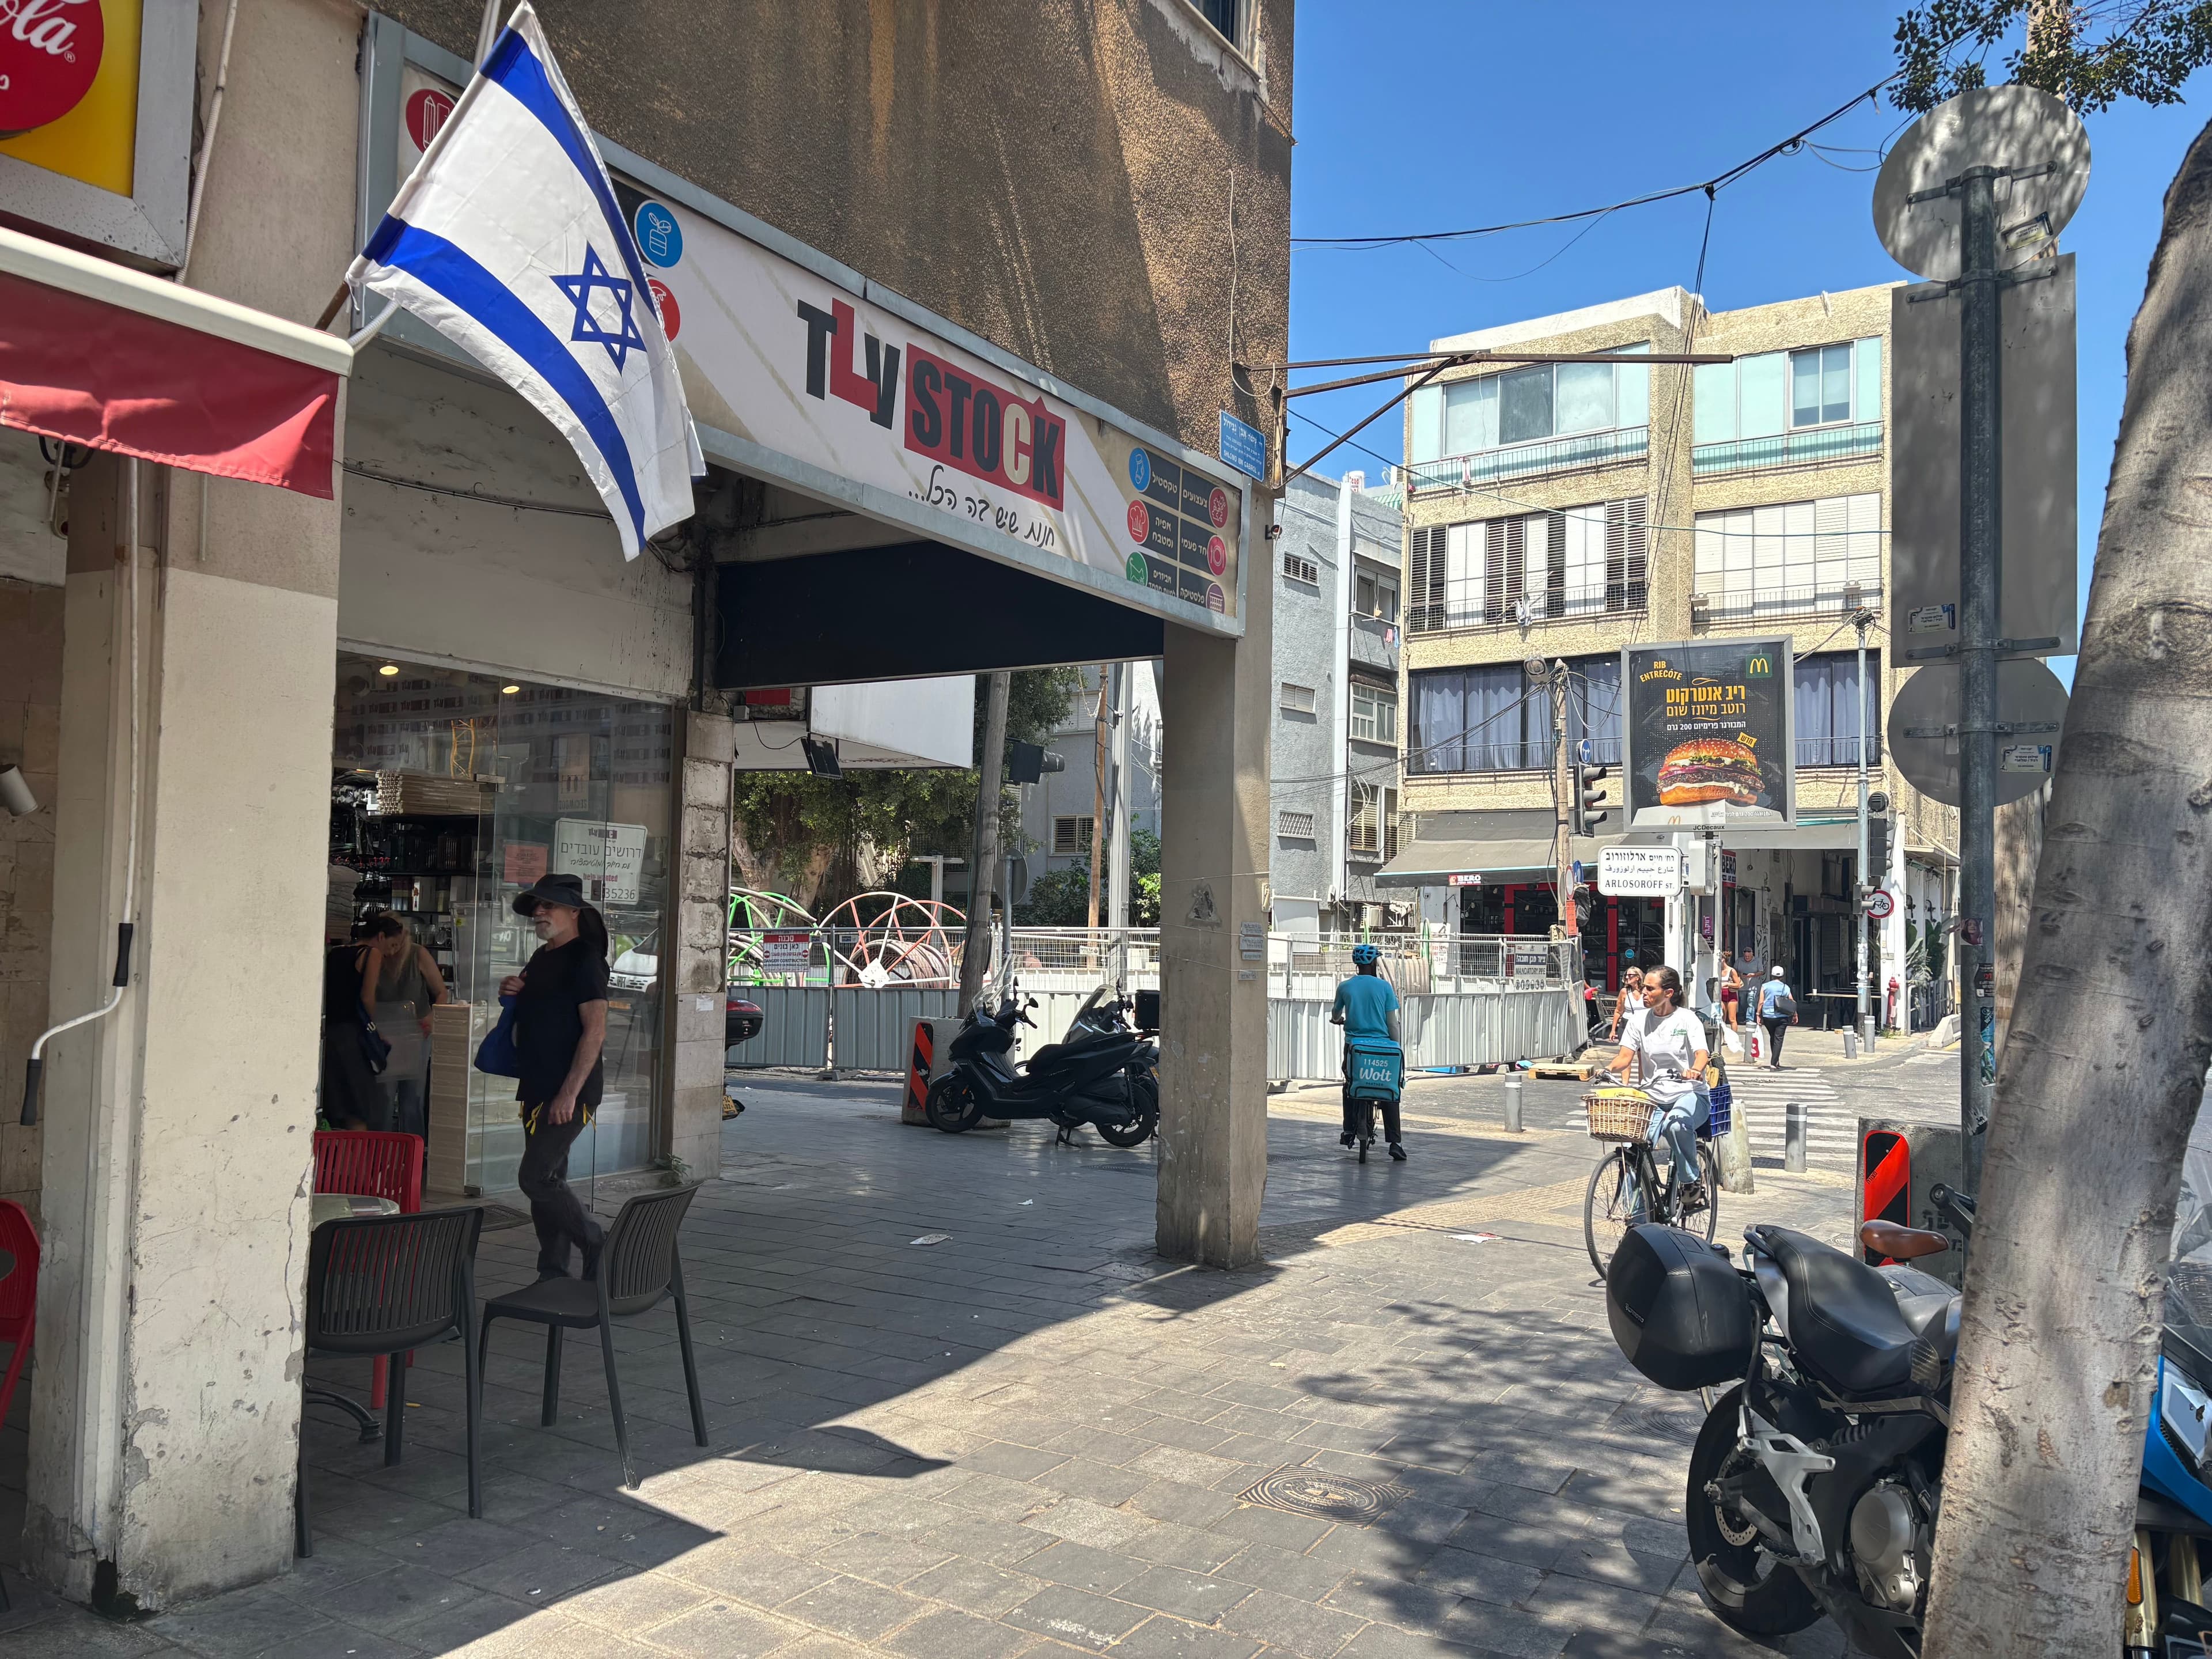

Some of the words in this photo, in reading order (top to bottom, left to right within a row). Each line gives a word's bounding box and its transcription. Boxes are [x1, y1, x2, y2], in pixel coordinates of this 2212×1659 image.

[912, 359, 1060, 500] STOCK
[1152, 471, 1177, 494] טקסטיל
[1183, 489, 1208, 508] צעצועים
[965, 497, 990, 521] בה
[995, 506, 1018, 533] שיש
[1156, 517, 1171, 532] אפיה
[1024, 521, 1055, 548] חנות
[1152, 531, 1173, 548] ומטבח
[1181, 537, 1197, 552] פעמי
[1198, 544, 1207, 556] חד
[1153, 570, 1172, 584] אביזרים
[1180, 587, 1205, 604] פלסטיקה
[1653, 661, 1666, 669] RIB
[1666, 686, 1722, 706] אנטרקוט
[1725, 685, 1745, 701] ריב
[1666, 705, 1688, 717] שום
[1691, 703, 1717, 716] מיונז
[1721, 703, 1745, 714] רוטב
[1740, 734, 1753, 745] חדש
[561, 842, 600, 855] עובדים
[605, 846, 642, 858] דרושים
[1605, 850, 1646, 861] ארלוזורוב
[1722, 855, 1736, 875] BERO
[1605, 880, 1663, 888] ARLOSOROFF
[1364, 1059, 1388, 1067] 114525
[1359, 1067, 1392, 1082] Wolt
